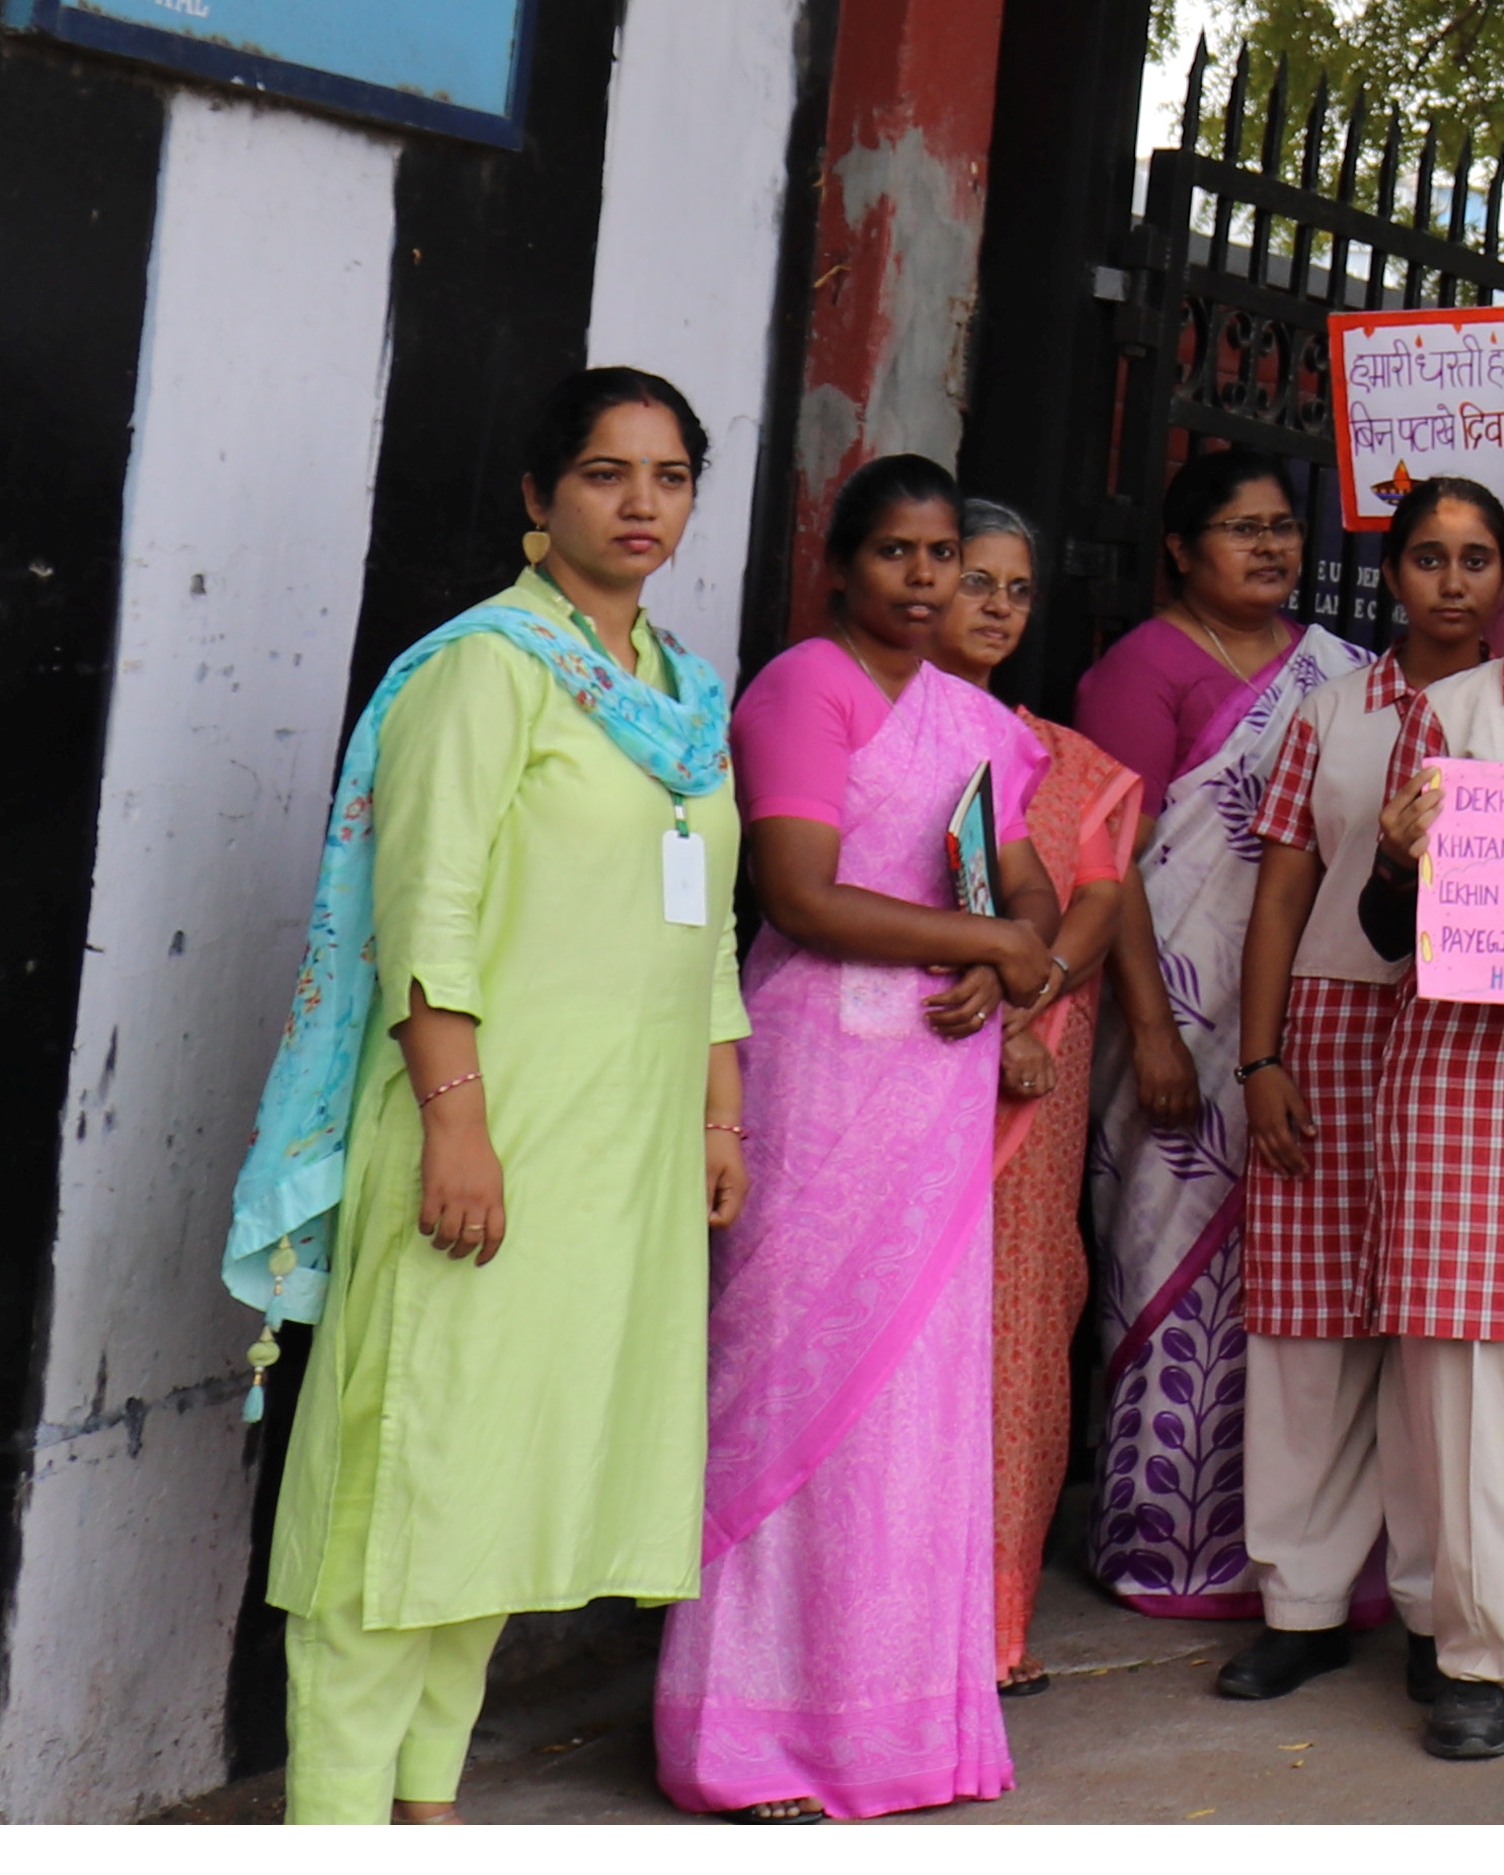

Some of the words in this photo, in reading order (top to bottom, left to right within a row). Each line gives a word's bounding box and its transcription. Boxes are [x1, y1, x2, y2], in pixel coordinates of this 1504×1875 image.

[1350, 338, 1412, 394] हमारी
[1350, 400, 1396, 457] बिन
[1438, 879, 1499, 907] LEKHIN
